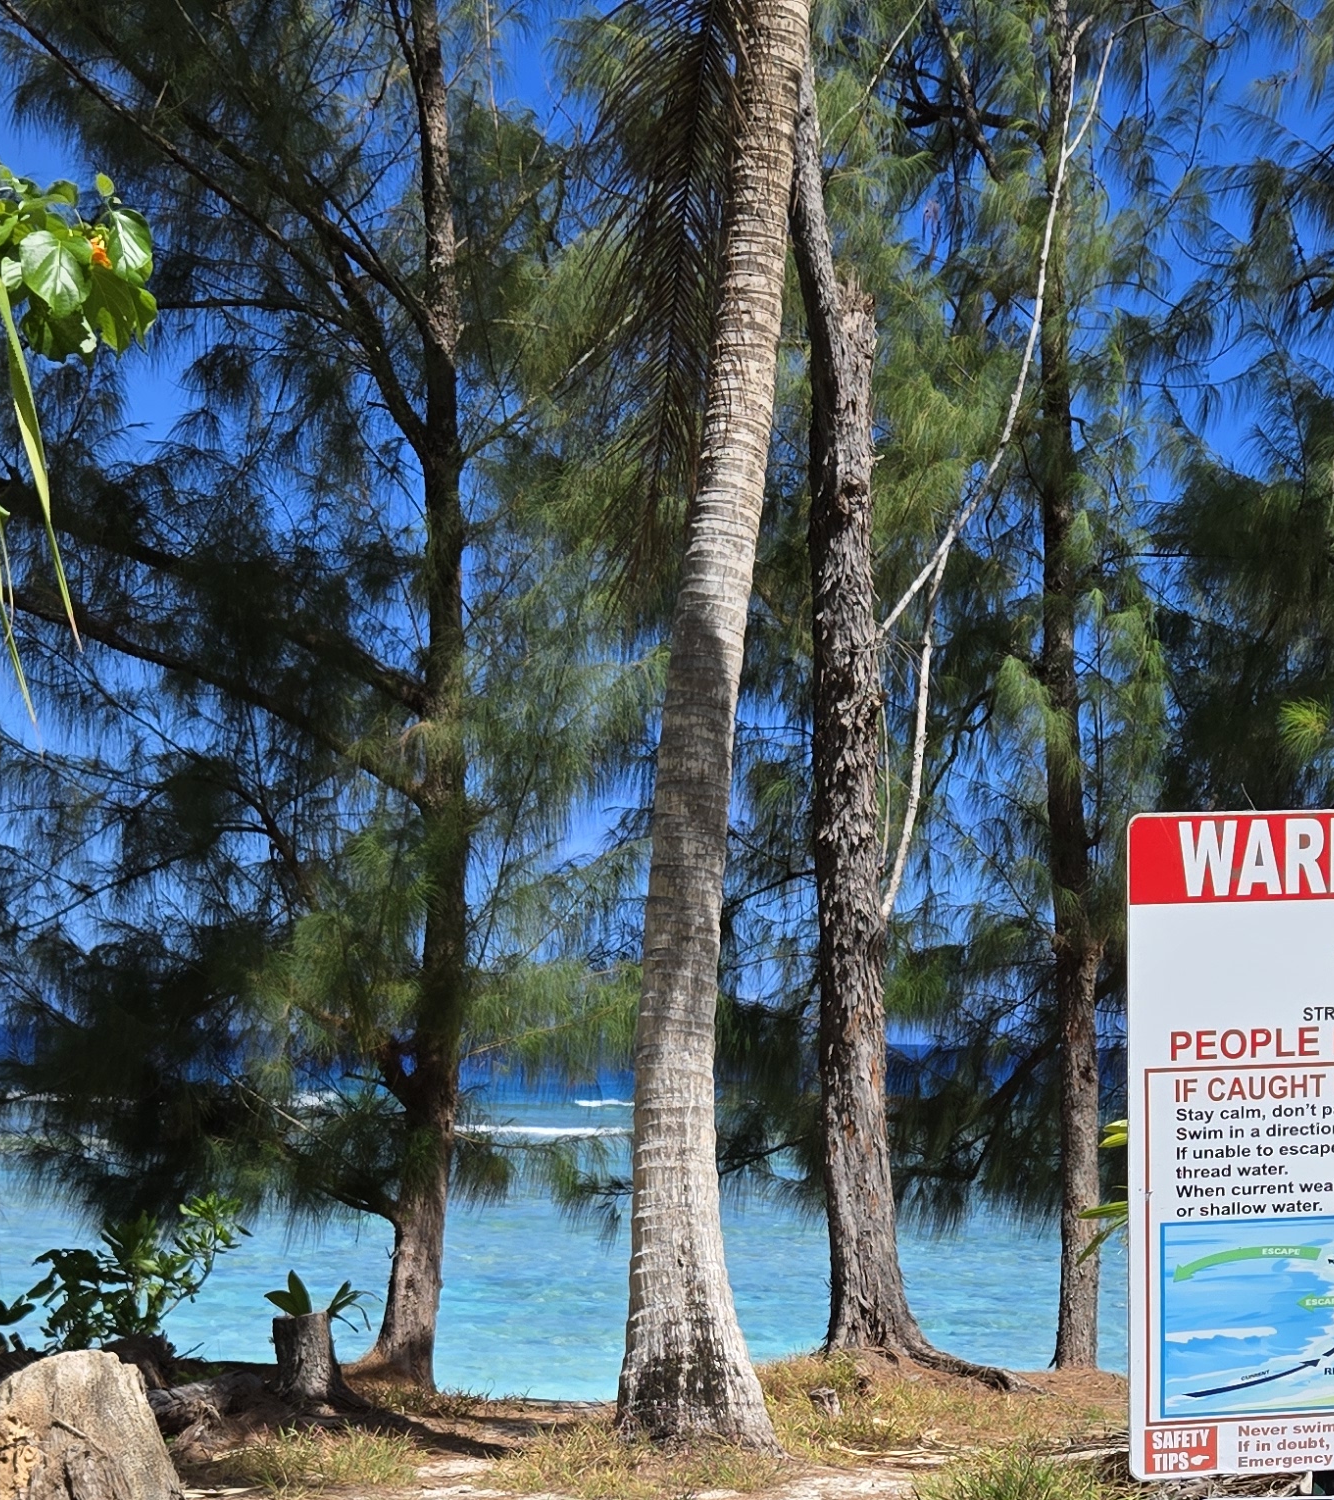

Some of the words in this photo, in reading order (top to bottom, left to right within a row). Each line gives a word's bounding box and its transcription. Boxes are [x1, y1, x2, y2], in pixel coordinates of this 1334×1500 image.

[1171, 1026, 1320, 1061] PEOPLE
[1175, 1079, 1198, 1102] IF
[1207, 1074, 1326, 1101] CAUGHT
[1176, 1108, 1214, 1124] Stay
[1220, 1106, 1266, 1121] calm,
[1176, 1126, 1223, 1141] Swim
[1229, 1125, 1244, 1139] in
[1250, 1127, 1260, 1138] a
[1176, 1146, 1190, 1160] If
[1192, 1145, 1251, 1159] unable
[1256, 1144, 1273, 1156] to
[1176, 1164, 1232, 1179] thread
[1237, 1164, 1289, 1177] water.
[1176, 1184, 1225, 1198] When
[1231, 1182, 1294, 1196] current
[1176, 1206, 1194, 1218] or
[1199, 1202, 1267, 1216] shallow
[1271, 1200, 1323, 1214] water.
[1261, 1248, 1301, 1256] ESCAPE
[1240, 1369, 1270, 1382] CURRENT
[1238, 1423, 1287, 1437] Never
[1152, 1429, 1210, 1450] SAFETY
[1238, 1440, 1250, 1452] If
[1255, 1438, 1271, 1451] in
[1277, 1436, 1330, 1451] doubt,
[1153, 1452, 1189, 1471] TIPS
[1237, 1453, 1333, 1469] Emergency
